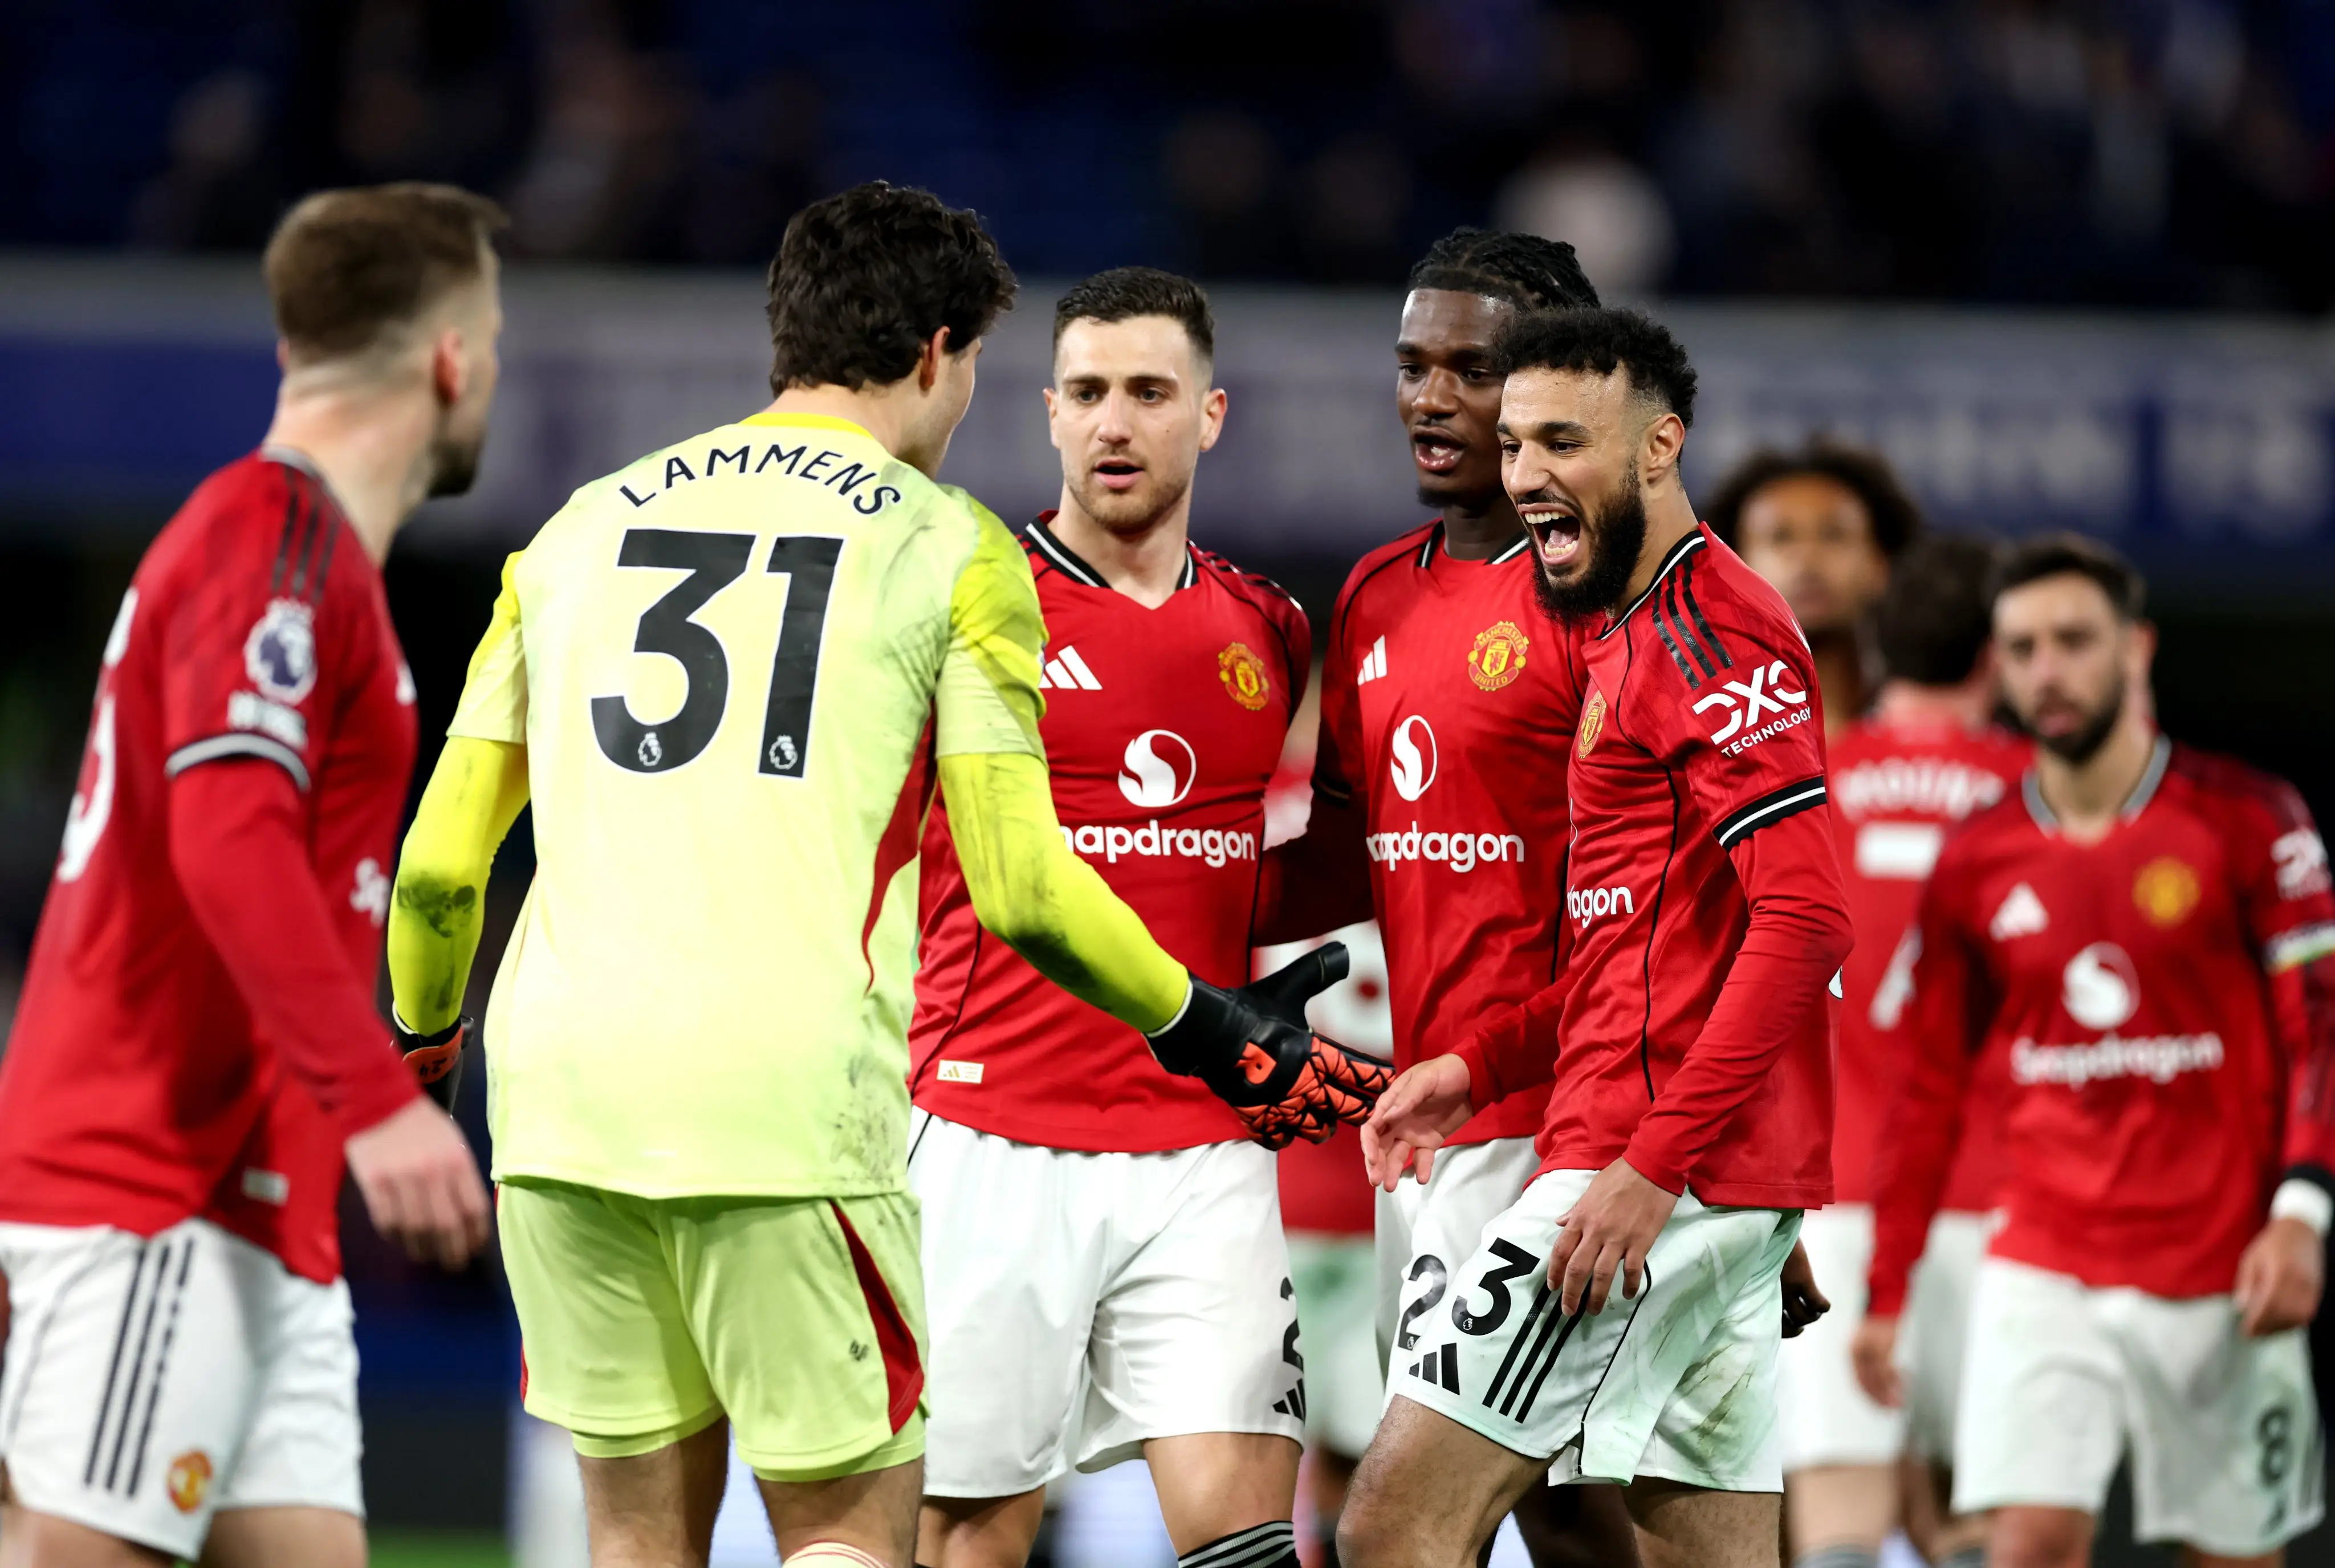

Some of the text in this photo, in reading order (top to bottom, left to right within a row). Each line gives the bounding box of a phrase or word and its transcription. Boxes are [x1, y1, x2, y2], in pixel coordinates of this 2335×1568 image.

[619, 443, 901, 515] LAMMENS
[591, 528, 844, 779] 31
[1474, 672, 1508, 686] UNITED
[1691, 659, 1807, 746] DXC
[1720, 706, 1811, 758] TECHNOLOGY
[1060, 818, 1256, 868] napdragon
[1397, 1254, 1448, 1351] 2
[1451, 1237, 1541, 1336] 3
